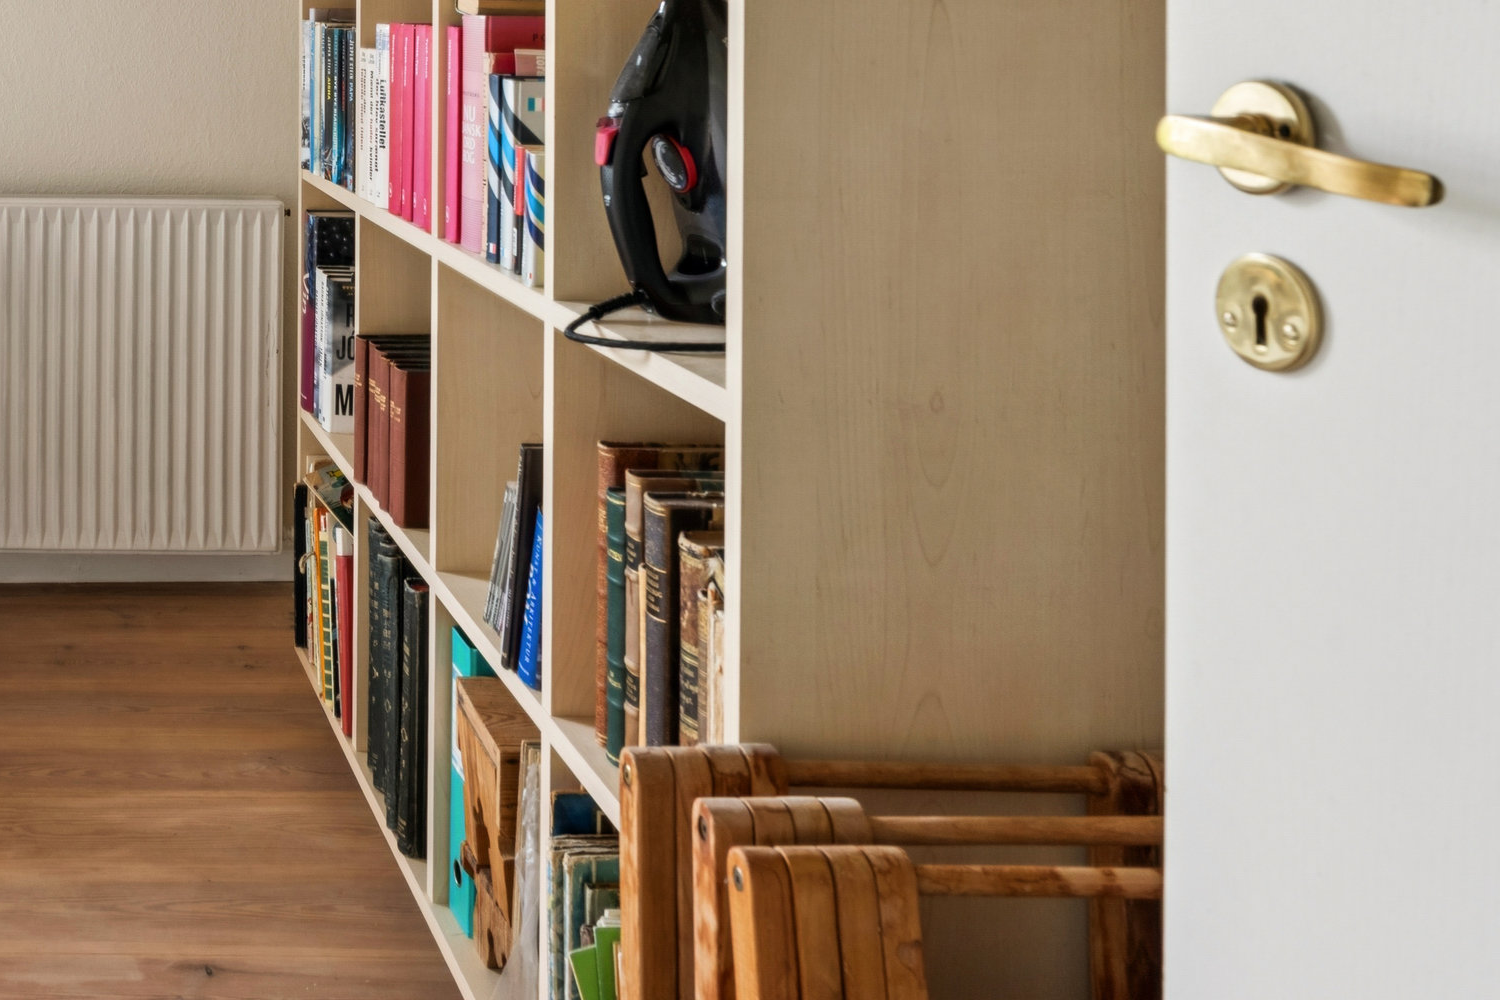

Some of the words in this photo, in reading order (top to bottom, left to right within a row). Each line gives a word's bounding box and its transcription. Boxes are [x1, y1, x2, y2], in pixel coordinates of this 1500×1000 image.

[379, 79, 387, 149] Luftkastellet
[335, 383, 354, 416] M
[532, 535, 543, 573] KUNST
[524, 592, 537, 663] ARKITEKTUR
